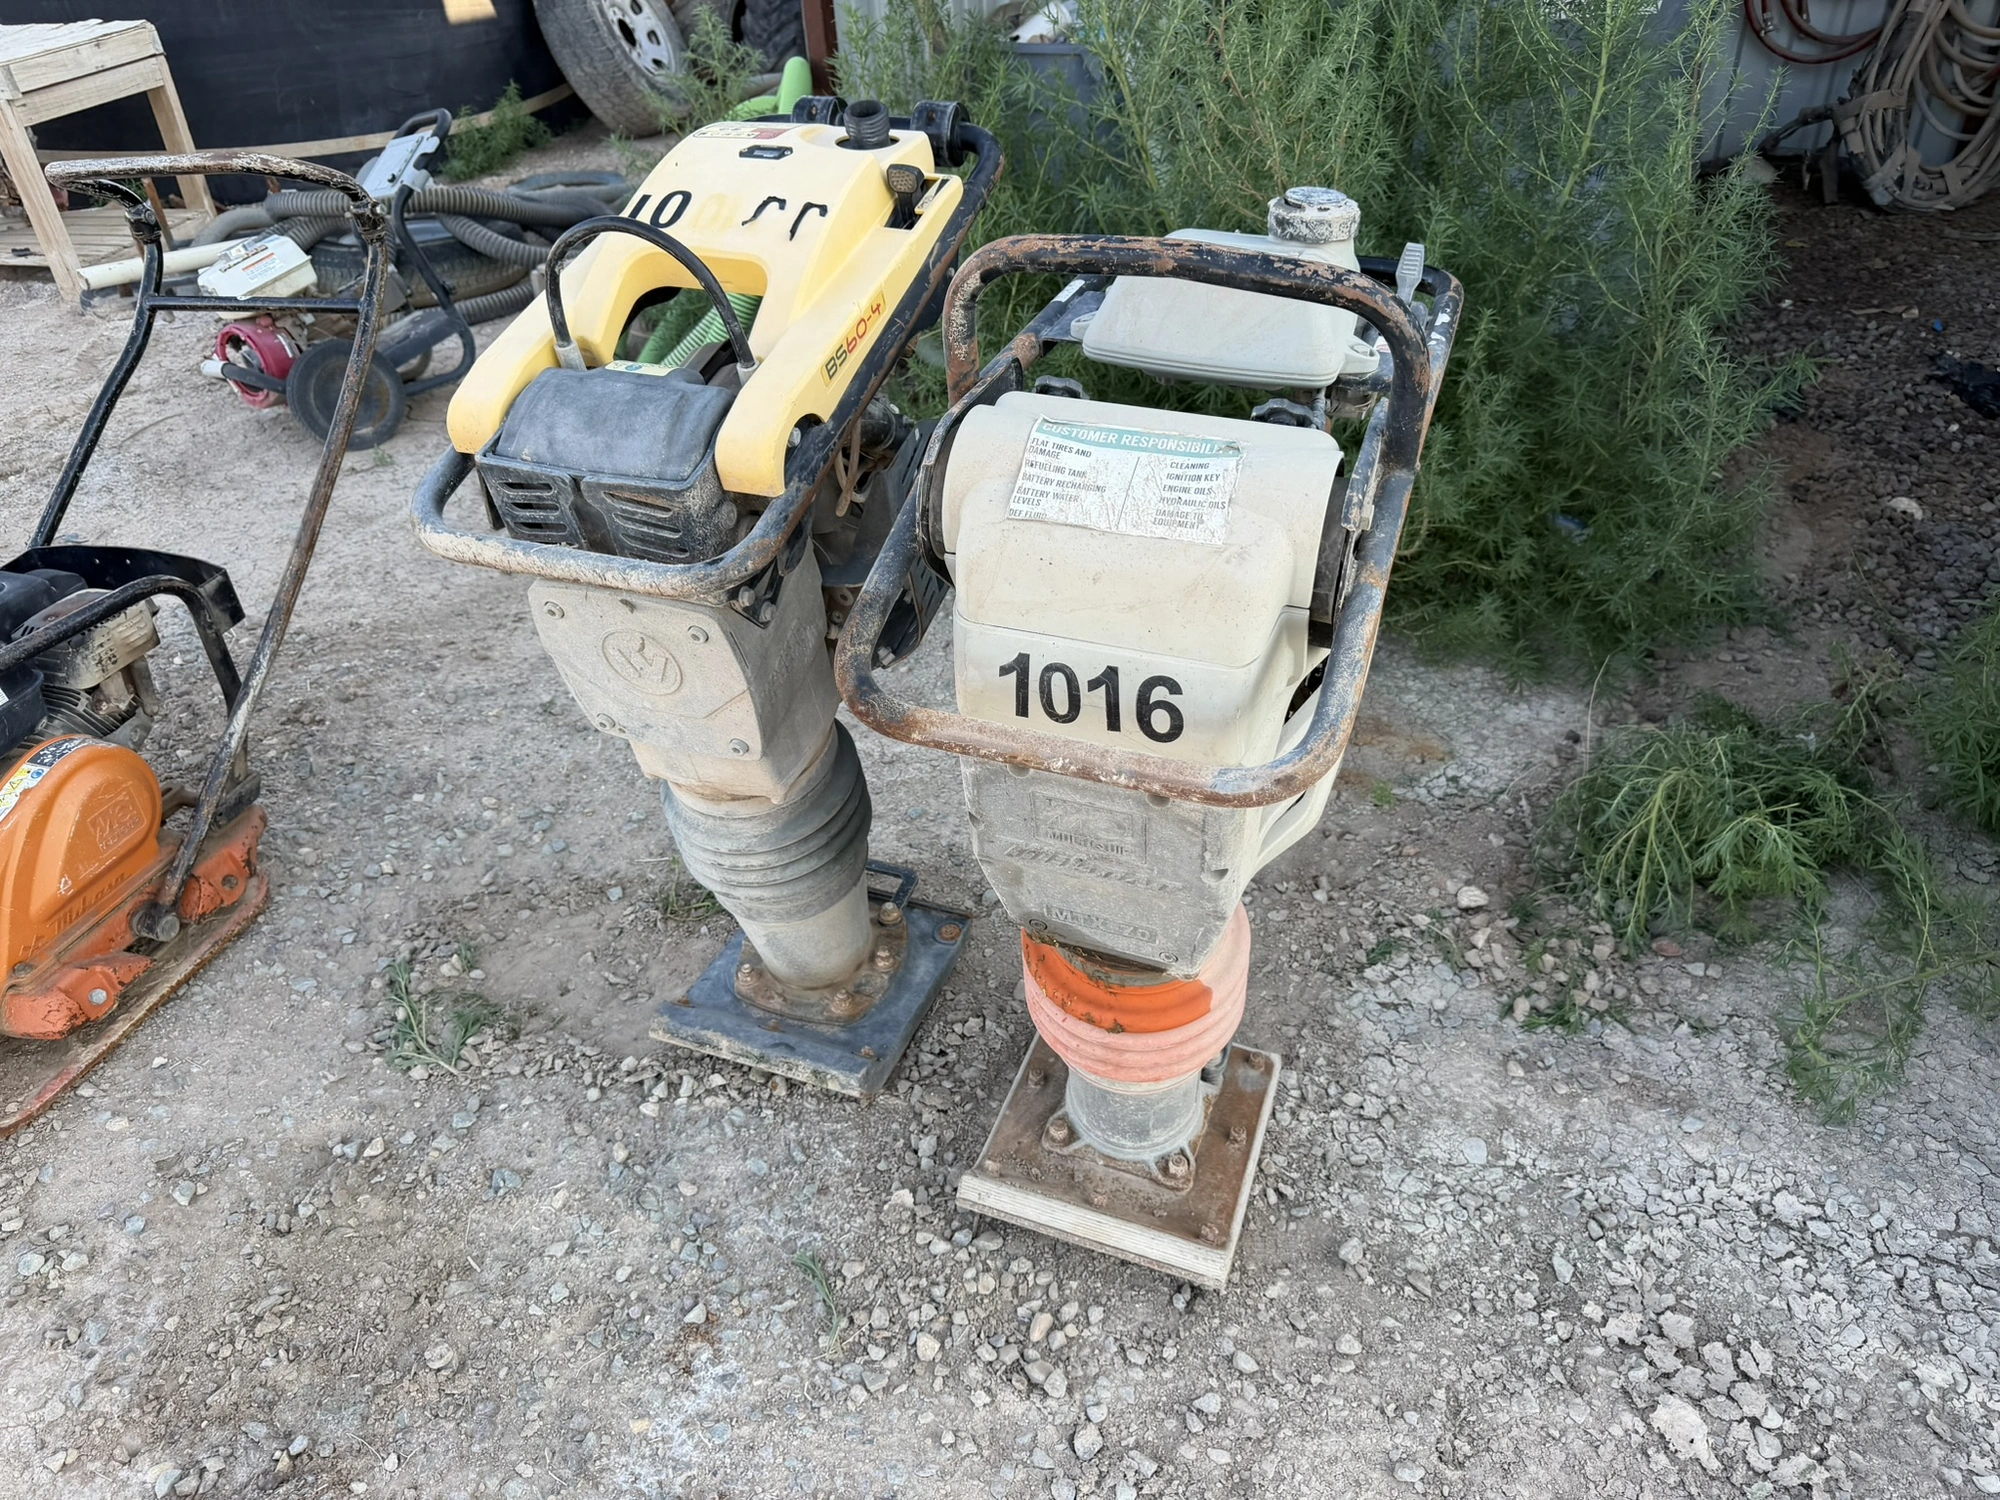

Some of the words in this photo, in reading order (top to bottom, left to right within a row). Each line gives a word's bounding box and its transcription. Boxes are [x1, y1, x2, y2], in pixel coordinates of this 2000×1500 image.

[825, 303, 881, 380] BS60-4
[1042, 422, 1119, 444] CUSTOMER
[1028, 446, 1061, 460] DAMAGE
[1032, 438, 1048, 448] FLAT
[1052, 442, 1074, 453] TIRES
[1074, 448, 1092, 458] AND
[1025, 459, 1066, 475] REFUELING
[1068, 468, 1088, 478] TANK
[1170, 461, 1210, 470] CLEANING
[1022, 472, 1055, 486] BATTERY
[1056, 480, 1106, 493] RECHARGING
[1166, 472, 1202, 482] IGNITION
[1204, 473, 1220, 482] KEY
[1016, 486, 1050, 498] BATTERY
[1052, 492, 1080, 502] WATER
[1162, 484, 1193, 494] ENGINE
[1194, 486, 1212, 496] OILS
[1012, 496, 1042, 506] LEVELS
[1159, 496, 1207, 508] HYDRAULIC
[1208, 500, 1226, 510] OILS
[1155, 508, 1191, 519] DAMAGE
[1192, 512, 1204, 520] TO
[1154, 517, 1201, 530] EQUIPMENT
[999, 652, 1184, 743] 1016
